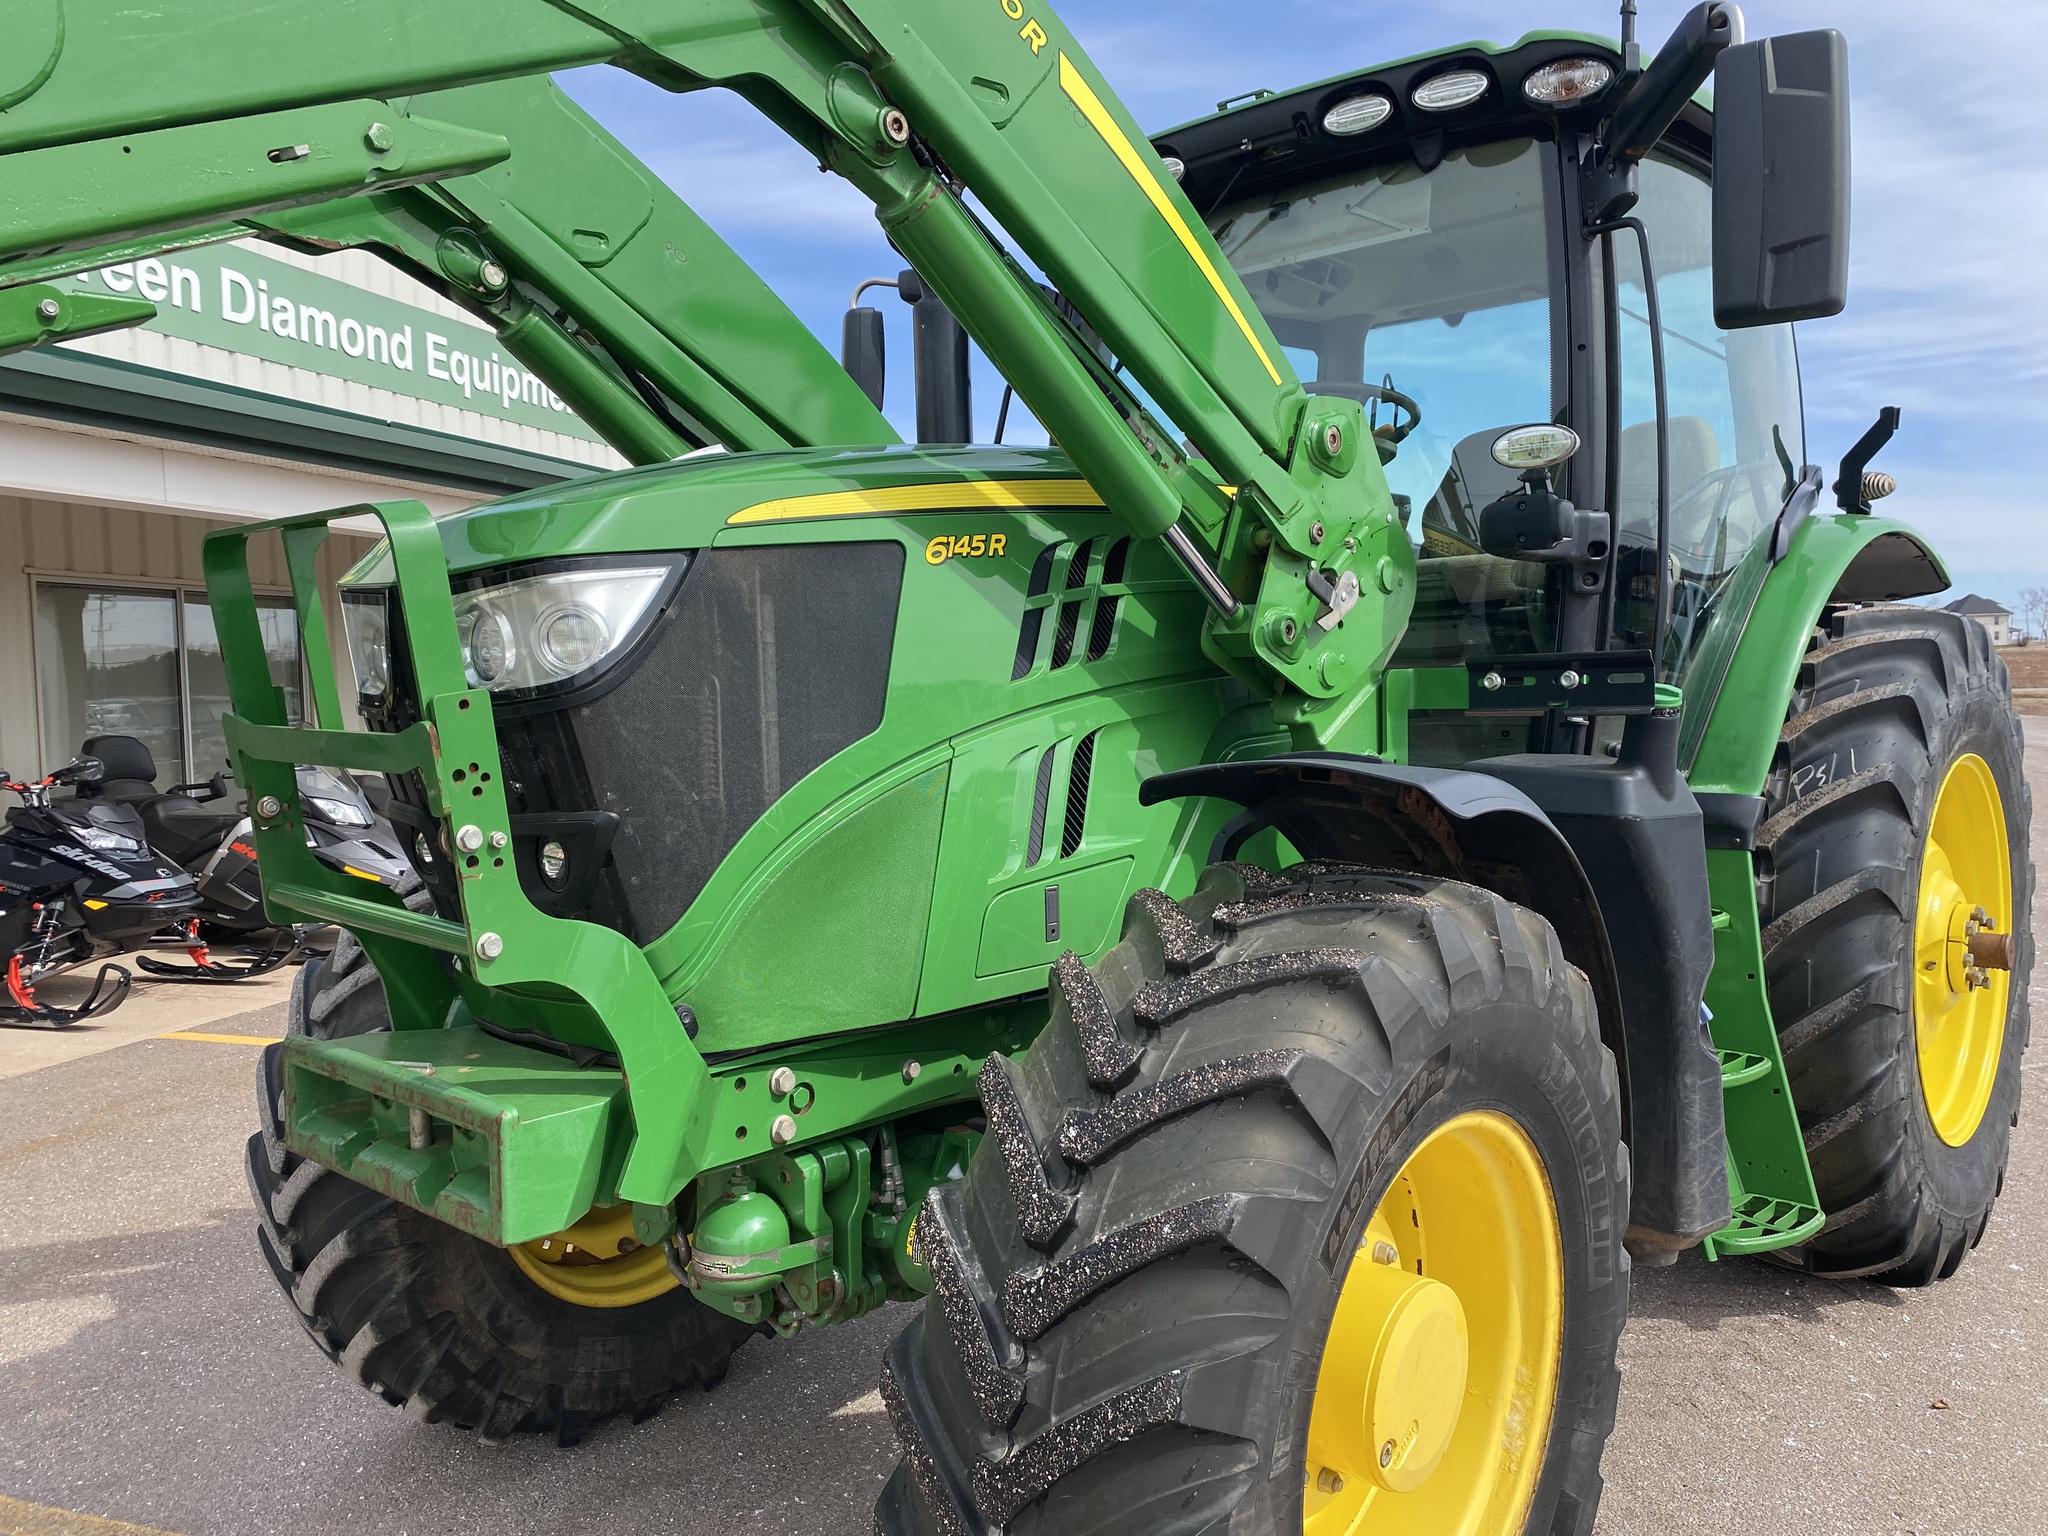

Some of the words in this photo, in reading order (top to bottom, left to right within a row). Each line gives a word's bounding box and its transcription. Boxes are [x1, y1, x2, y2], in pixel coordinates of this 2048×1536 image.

[76, 256, 201, 313] een
[220, 266, 413, 371] Diamond
[426, 331, 579, 417] Equipme
[1558, 1084, 1612, 1278] MICHELIN
